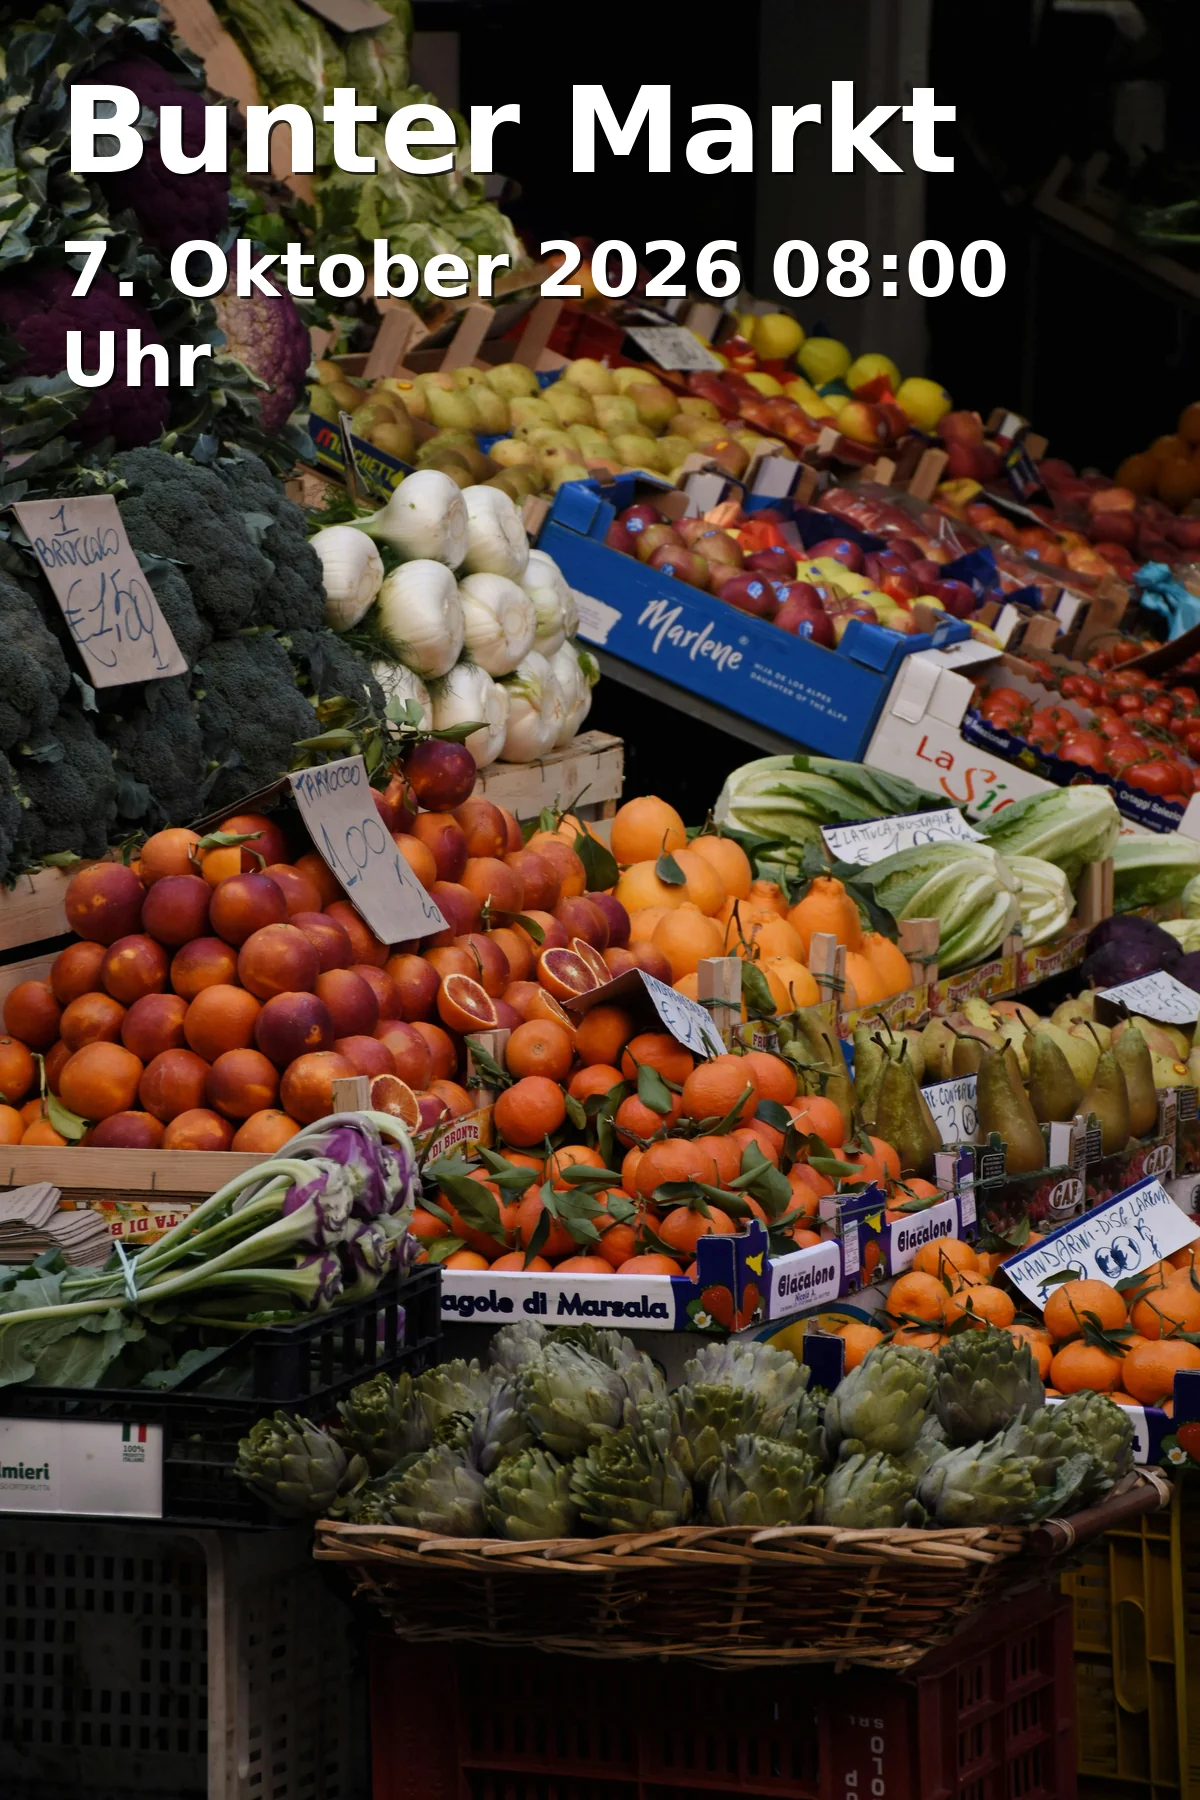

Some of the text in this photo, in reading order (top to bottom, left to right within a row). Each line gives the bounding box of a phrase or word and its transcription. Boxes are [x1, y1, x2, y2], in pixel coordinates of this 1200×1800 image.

[637, 598, 744, 672] Marlene
[750, 671, 848, 722] DAUGHTER OF THE ALPS
[788, 679, 804, 691] LOS
[806, 687, 832, 704] ALPES
[915, 735, 955, 772] La
[431, 1125, 479, 1158] DI BRONTE
[1146, 1150, 1170, 1176] GAF
[1052, 1182, 1080, 1208] GAF
[104, 1212, 190, 1236] TA DI B
[897, 1218, 953, 1253] Giacalone
[777, 1265, 835, 1298] Giacalone
[522, 1290, 548, 1315] di
[556, 1291, 669, 1319] Marsala
[123, 1444, 145, 1453] 100%
